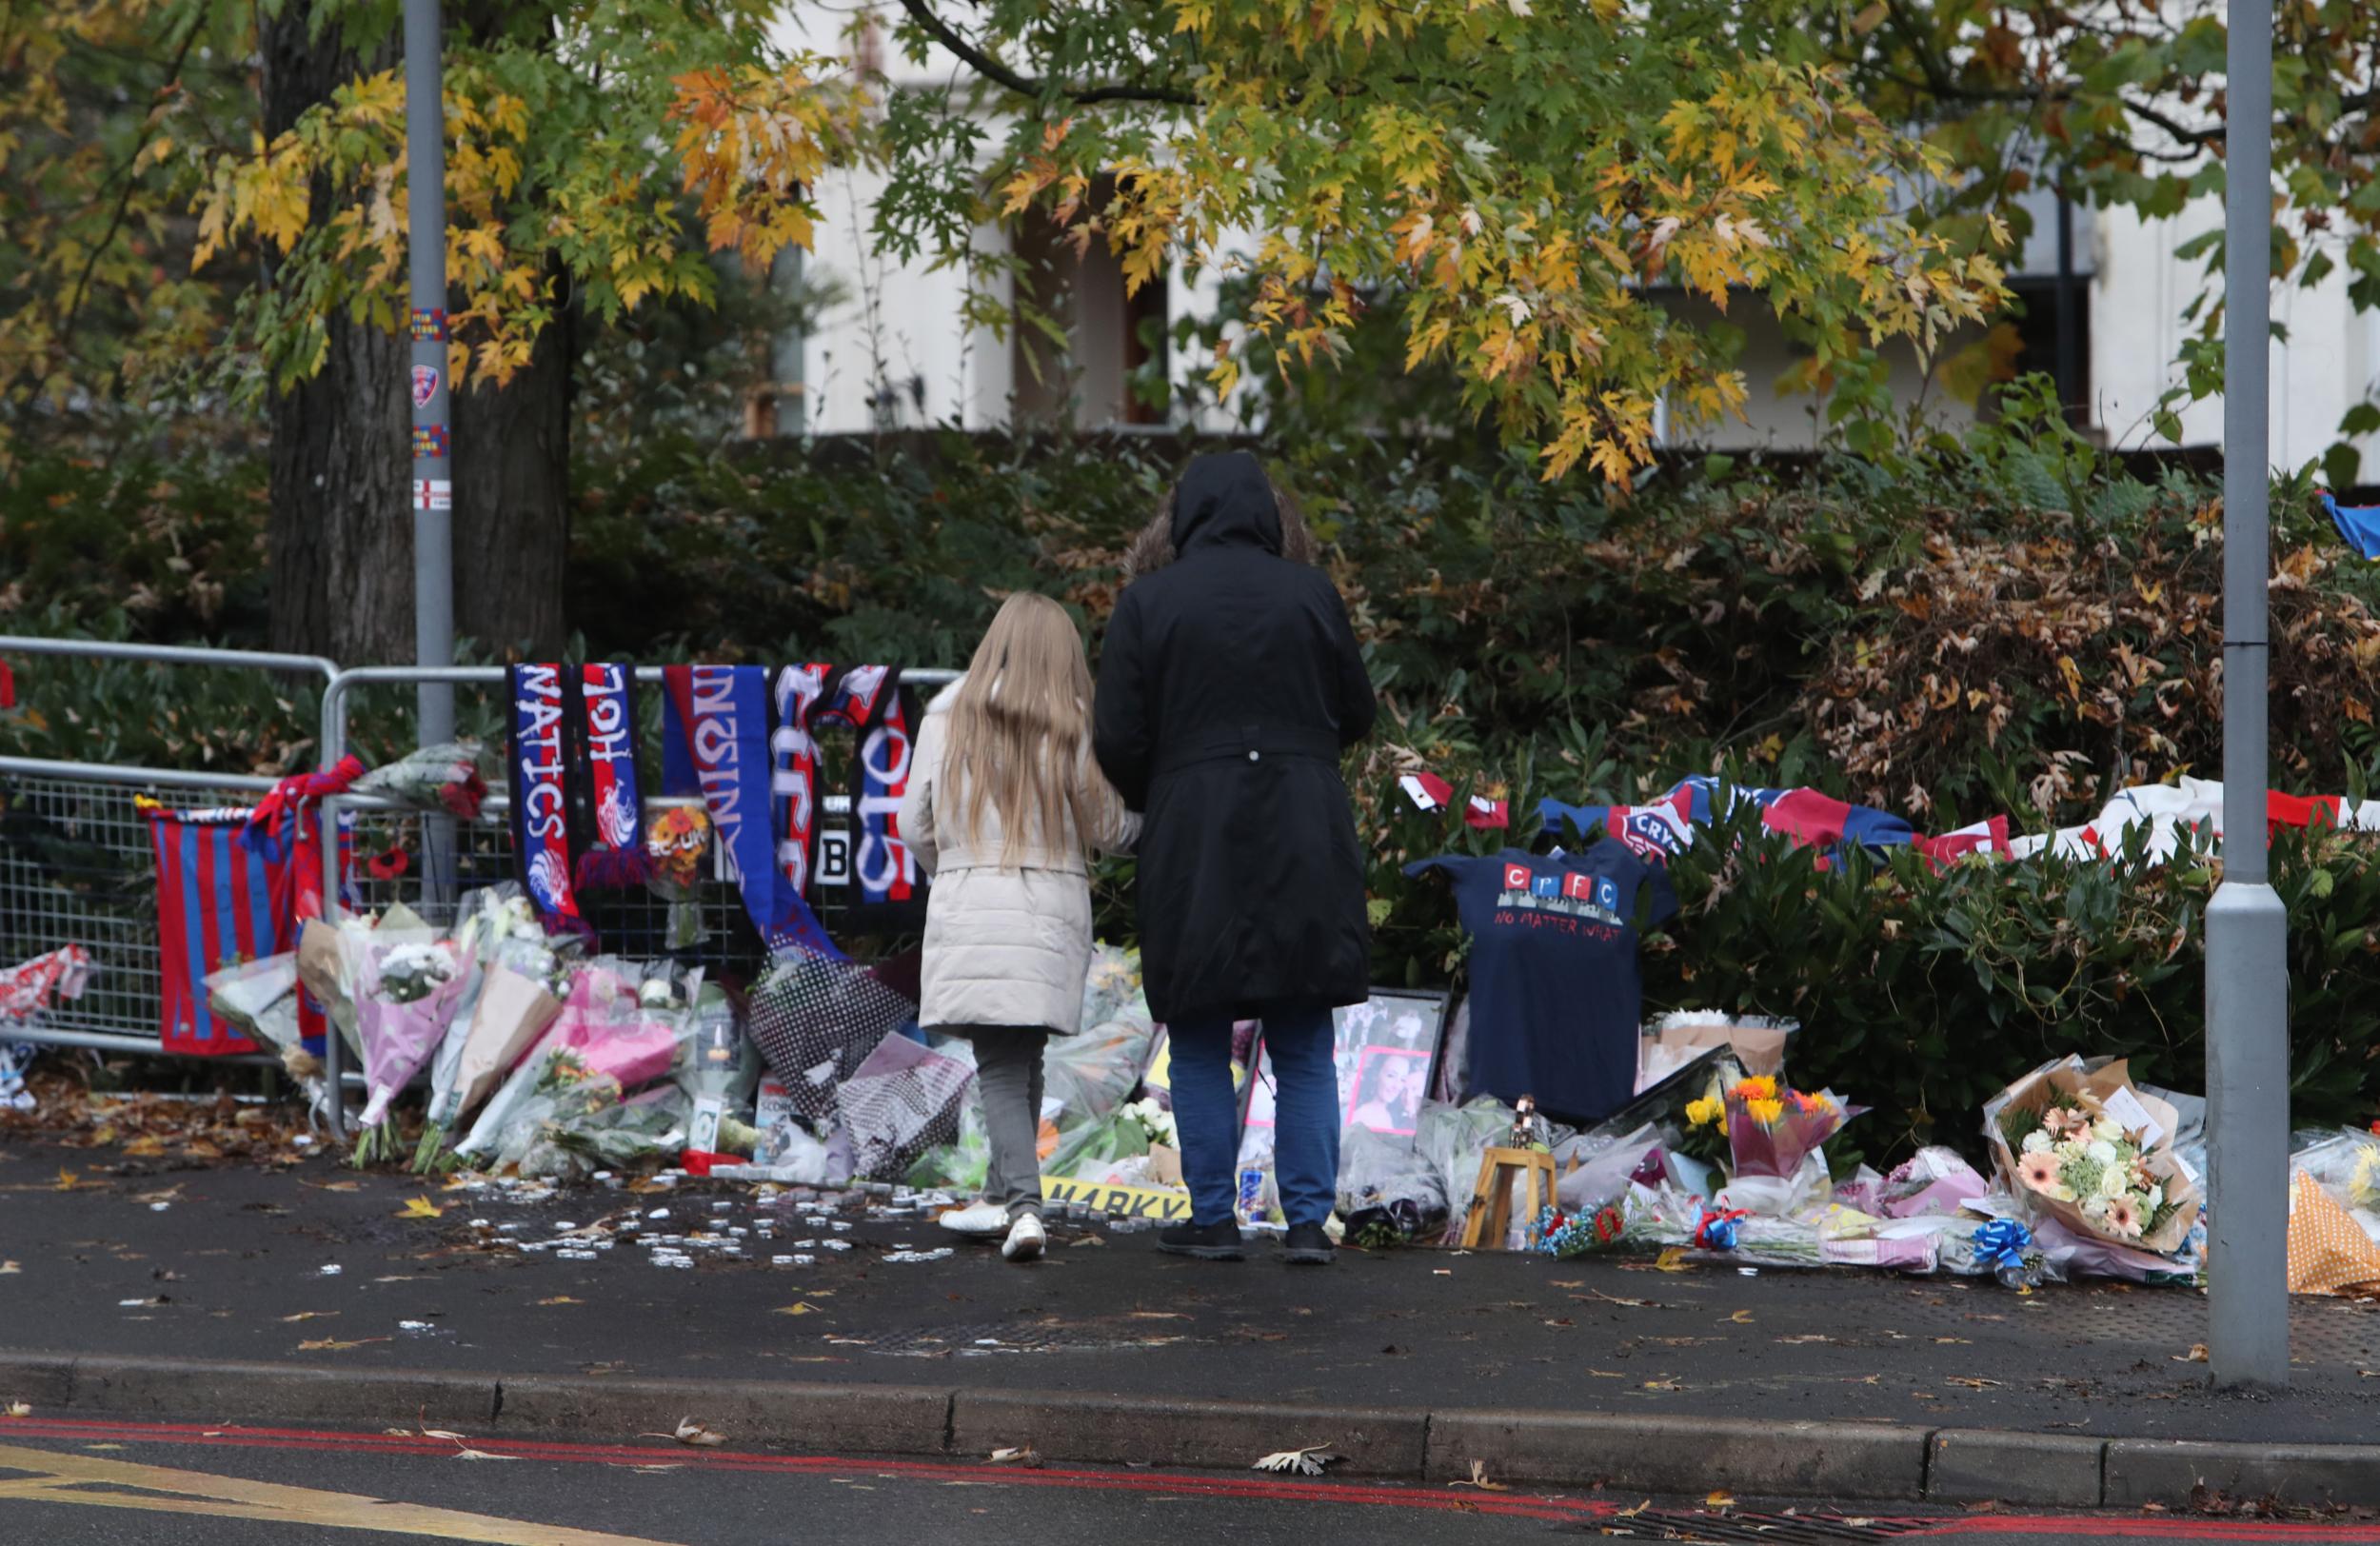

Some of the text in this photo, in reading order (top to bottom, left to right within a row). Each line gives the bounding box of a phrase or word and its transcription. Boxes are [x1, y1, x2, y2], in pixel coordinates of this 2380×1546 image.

[822, 839, 847, 876] B
[1494, 911, 1622, 942] NO MATTER WHAT
